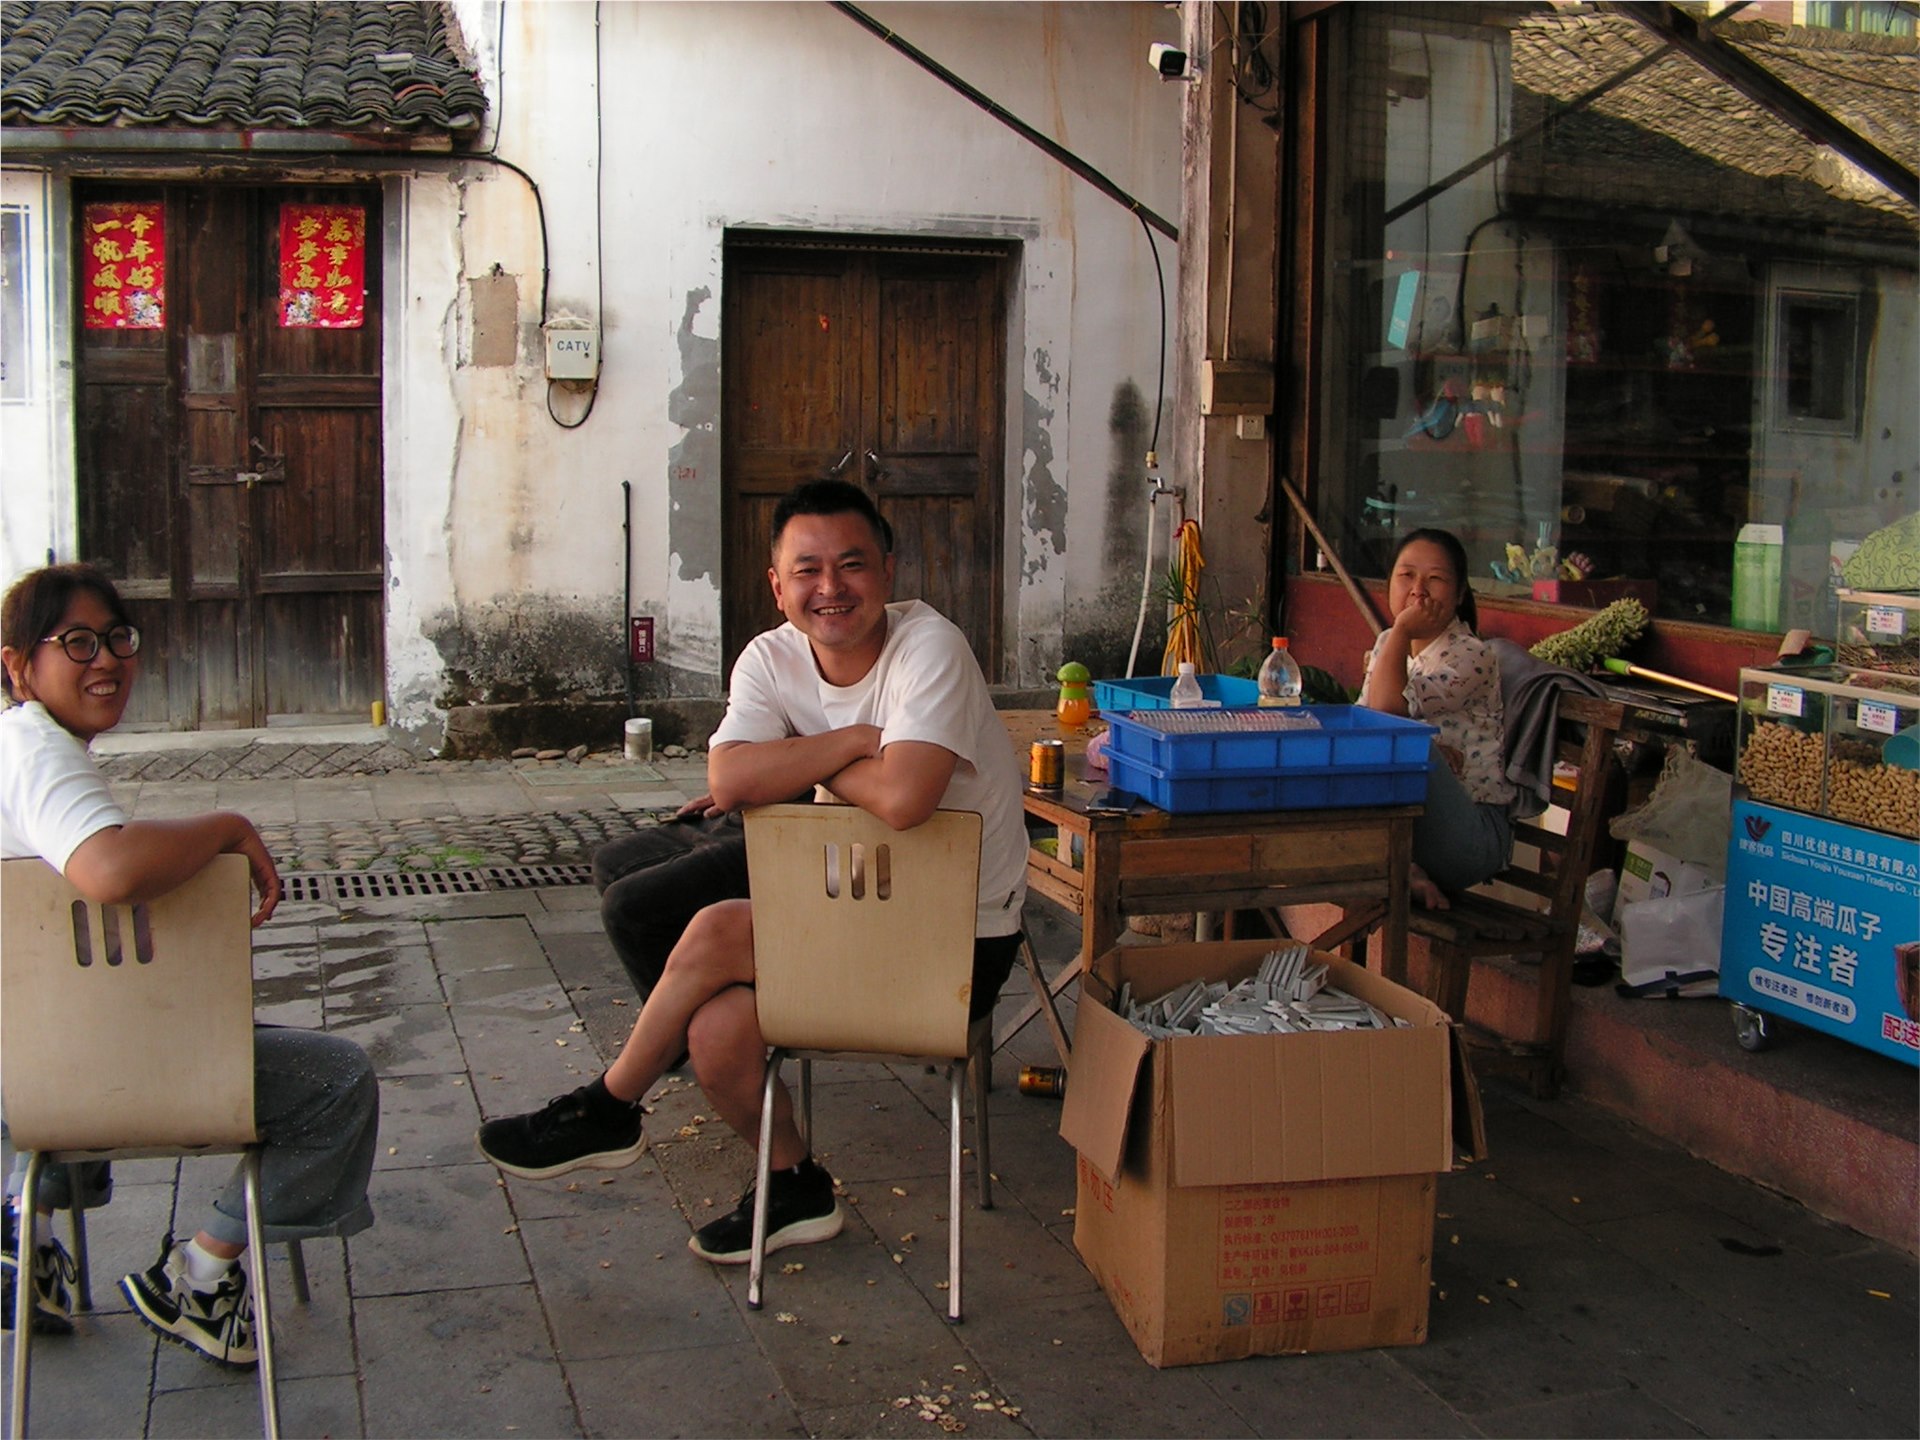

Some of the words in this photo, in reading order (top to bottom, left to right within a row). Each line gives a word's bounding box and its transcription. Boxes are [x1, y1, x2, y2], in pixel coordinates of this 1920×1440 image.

[557, 341, 590, 351] CATV
[1866, 873, 1894, 891] Trading
[1748, 879, 1882, 942] 中国高端瓜子
[1759, 922, 1860, 988] 专注者
